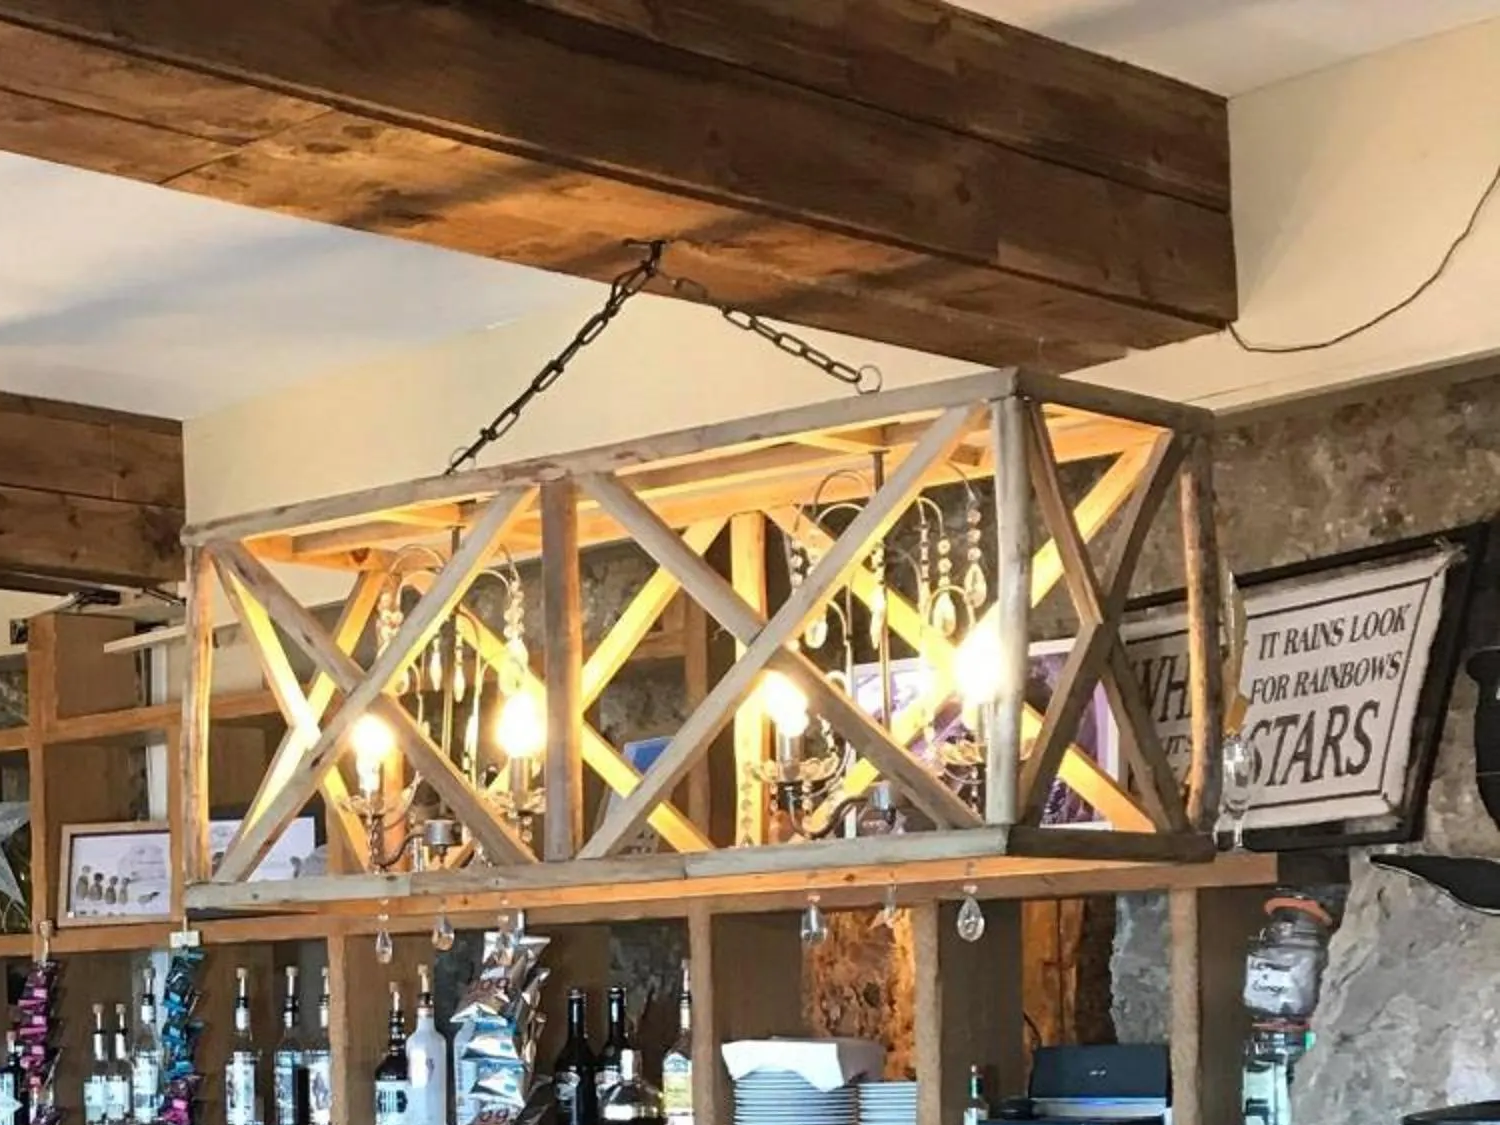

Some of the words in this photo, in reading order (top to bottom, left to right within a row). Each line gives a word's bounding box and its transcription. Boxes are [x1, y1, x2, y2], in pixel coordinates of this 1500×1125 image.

[1258, 632, 1281, 661] IT
[1283, 621, 1345, 656] RAINS
[1348, 603, 1412, 643] LOOK
[1250, 671, 1289, 705] FOR
[1296, 650, 1406, 697] RAINBOWS
[1248, 699, 1380, 788] STARS
